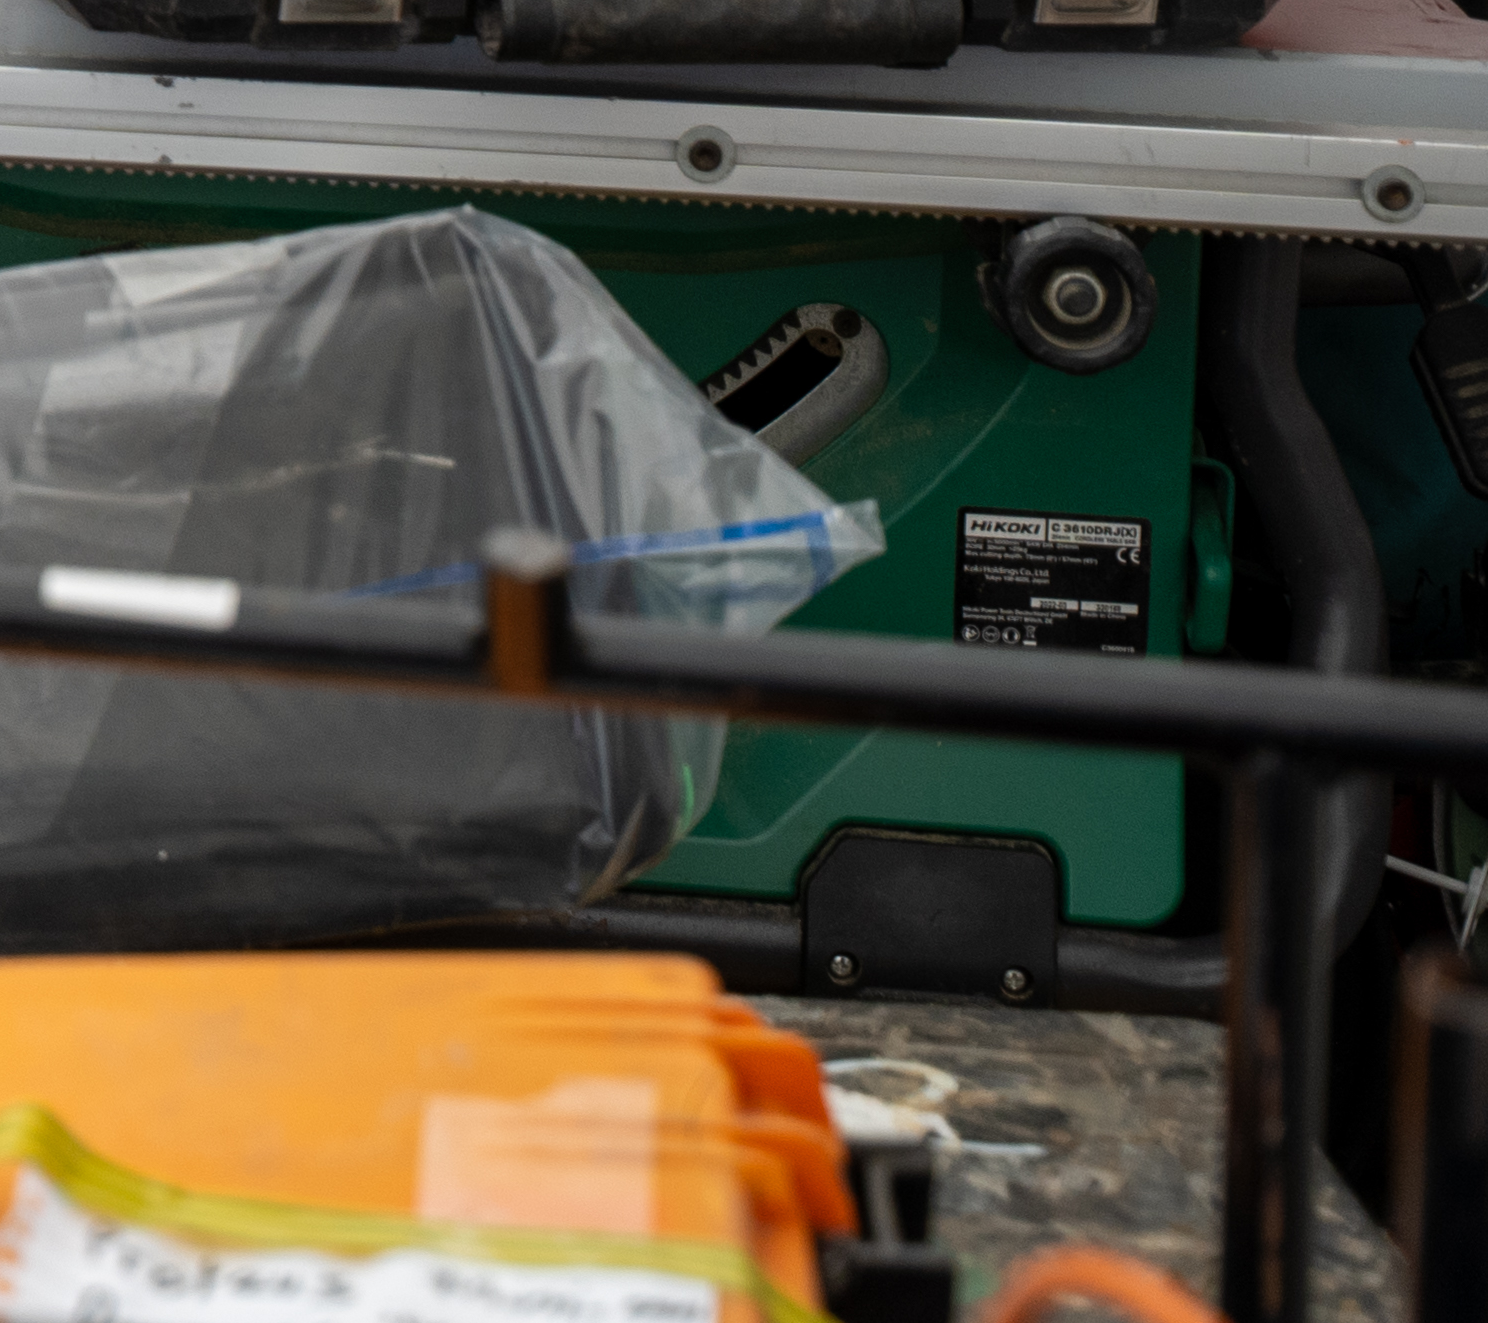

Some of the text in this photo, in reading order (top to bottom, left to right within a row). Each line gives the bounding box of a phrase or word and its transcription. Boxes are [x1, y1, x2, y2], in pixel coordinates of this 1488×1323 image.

[970, 519, 1138, 539] HiKOKI C 3610DRJ(X)
